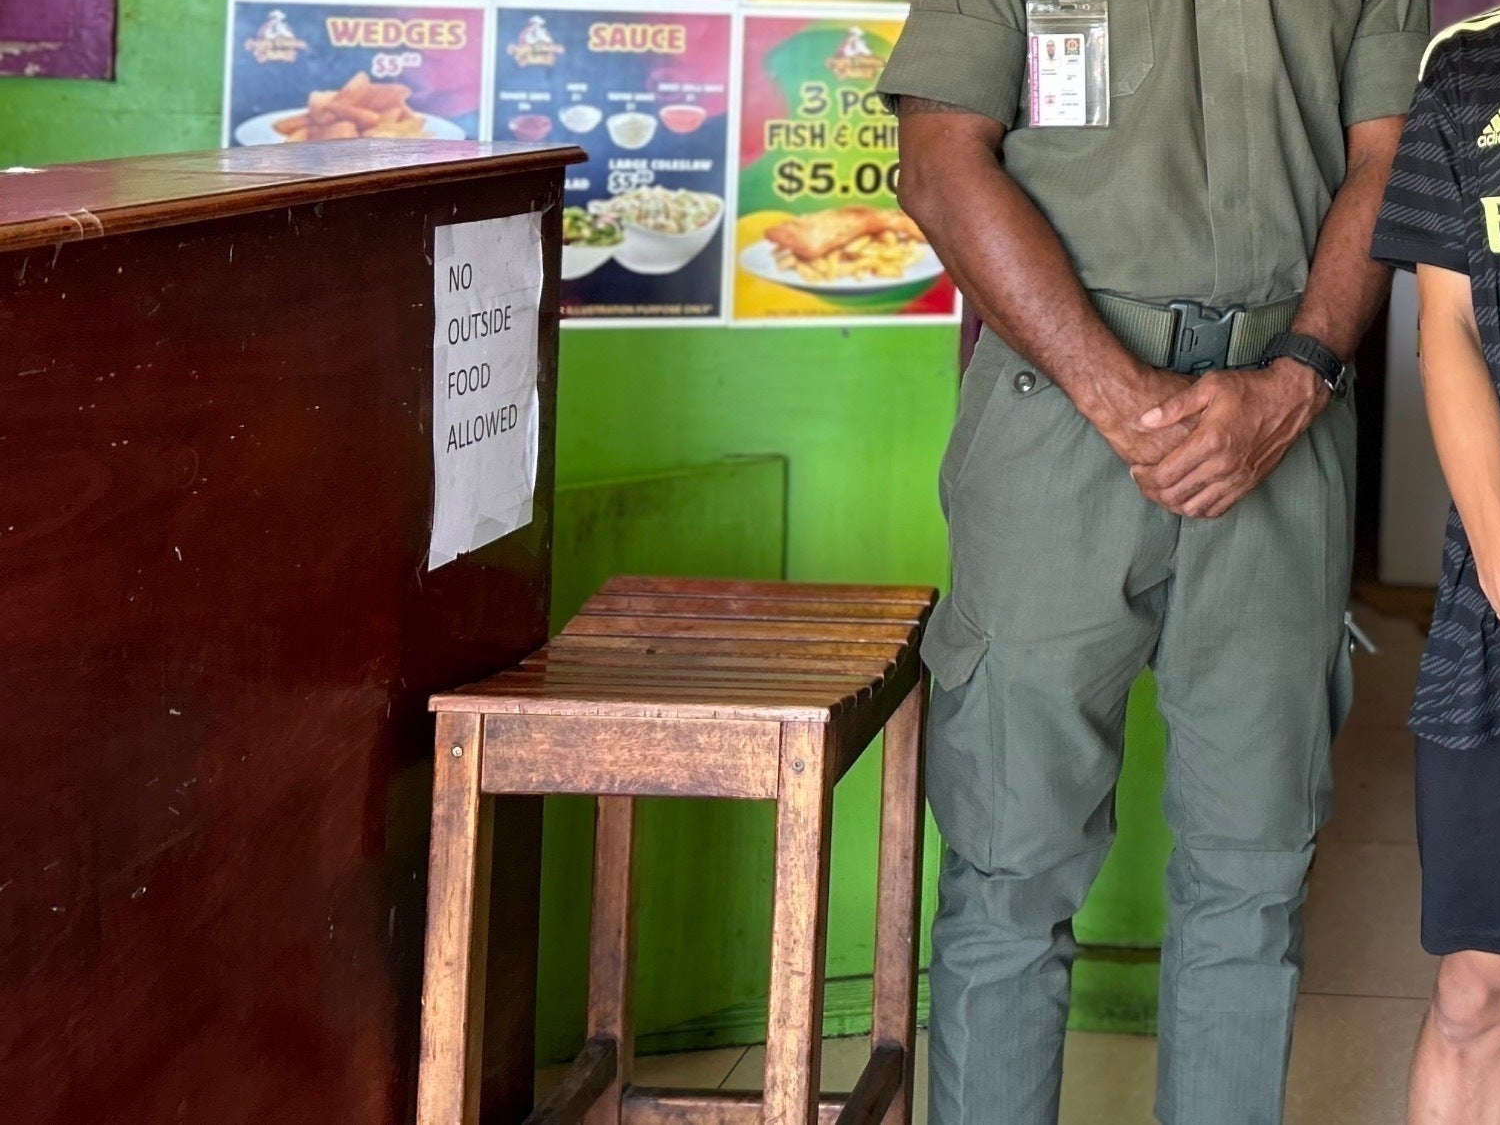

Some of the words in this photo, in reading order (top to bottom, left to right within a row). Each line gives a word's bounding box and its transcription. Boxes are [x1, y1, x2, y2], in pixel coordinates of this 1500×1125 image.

[326, 19, 466, 49] WEDGES
[590, 25, 685, 52] SAUCE
[802, 84, 829, 115] 3
[767, 123, 827, 149] FISH
[834, 124, 851, 148] &
[857, 123, 897, 149] CHI
[608, 158, 649, 172] LARGE
[448, 262, 473, 293] NO
[448, 304, 512, 345] OUTSIDE
[448, 362, 491, 400] FOOD
[446, 403, 518, 454] ALLOWED
